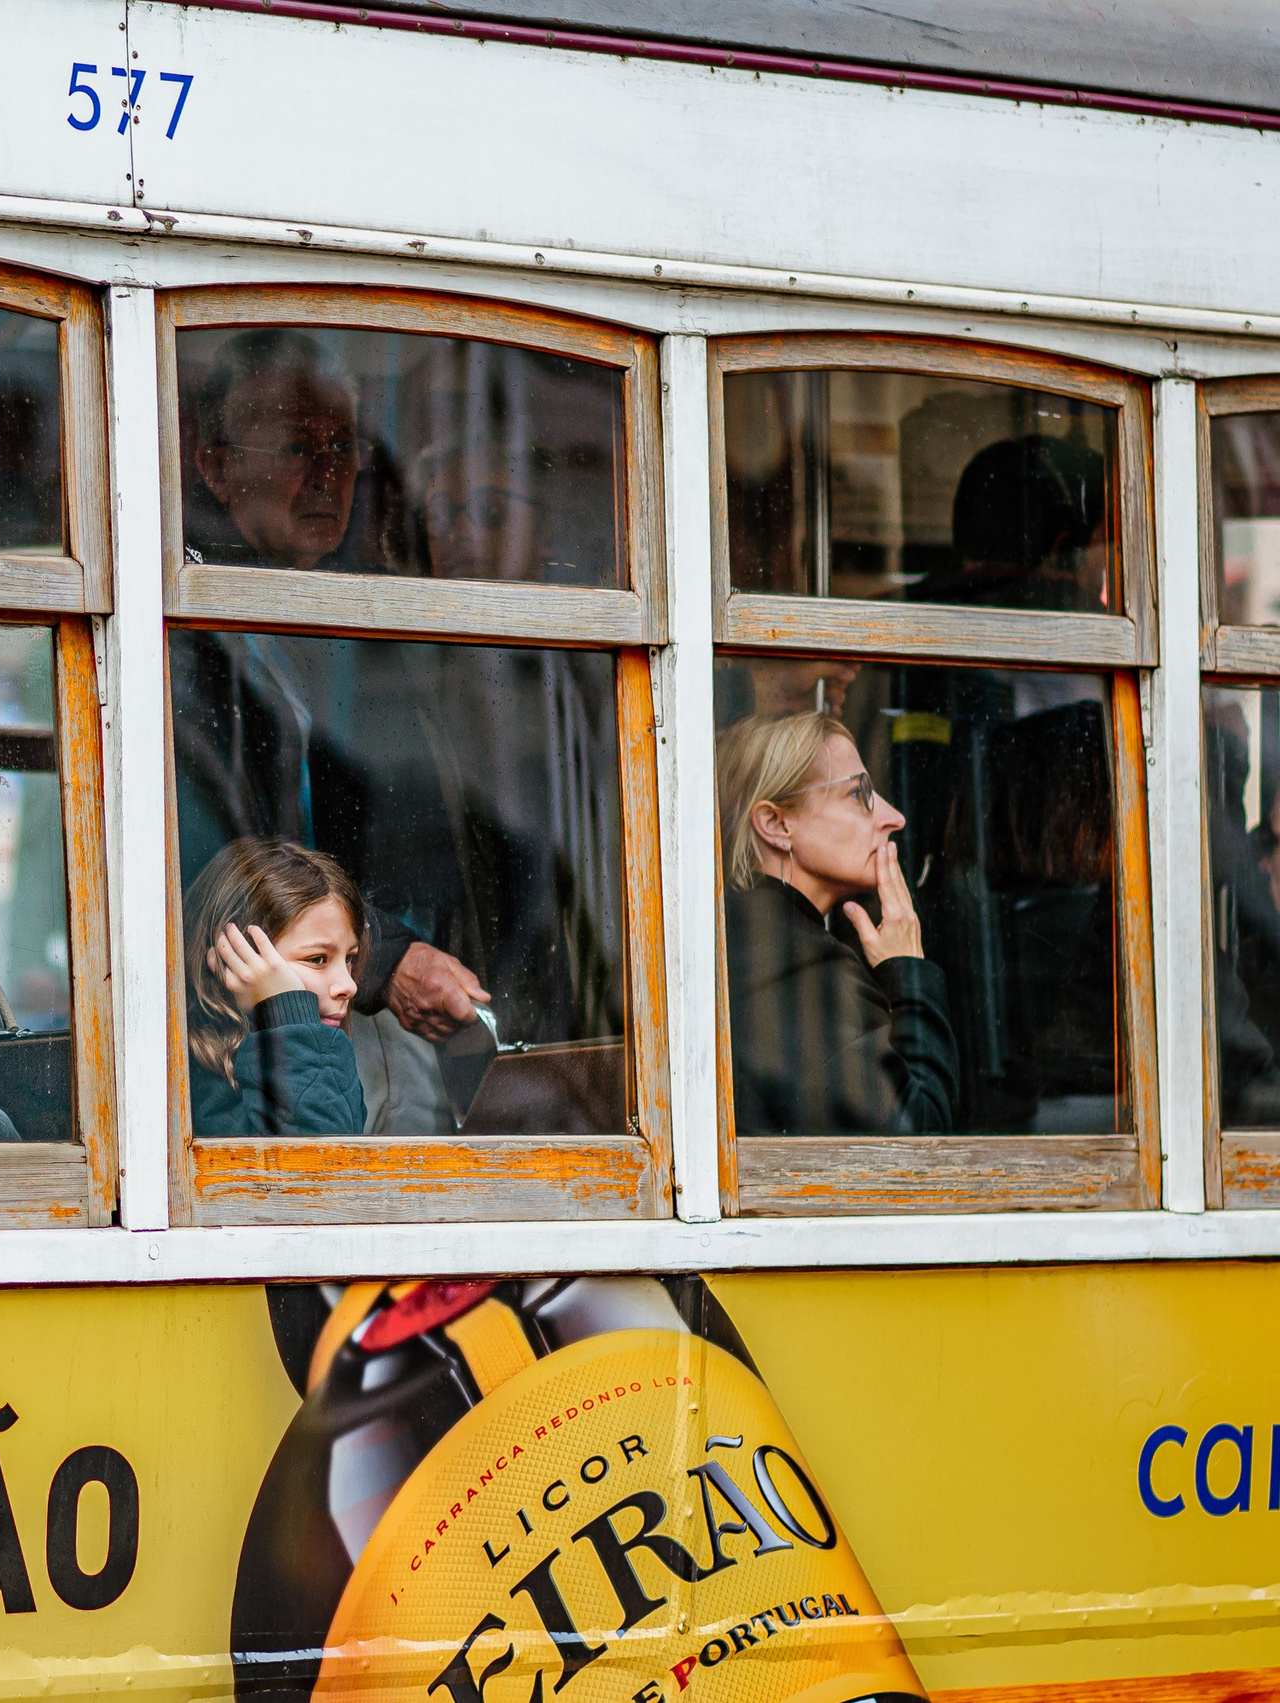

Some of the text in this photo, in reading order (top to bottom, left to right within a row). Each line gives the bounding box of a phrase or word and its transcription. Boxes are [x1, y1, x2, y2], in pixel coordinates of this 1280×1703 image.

[67, 62, 194, 140] 577
[410, 1445, 524, 1571] CARRANCA
[535, 1382, 642, 1440] REDONDO
[482, 1434, 650, 1569] LICOR
[668, 1594, 859, 1692] PORTUGAL
